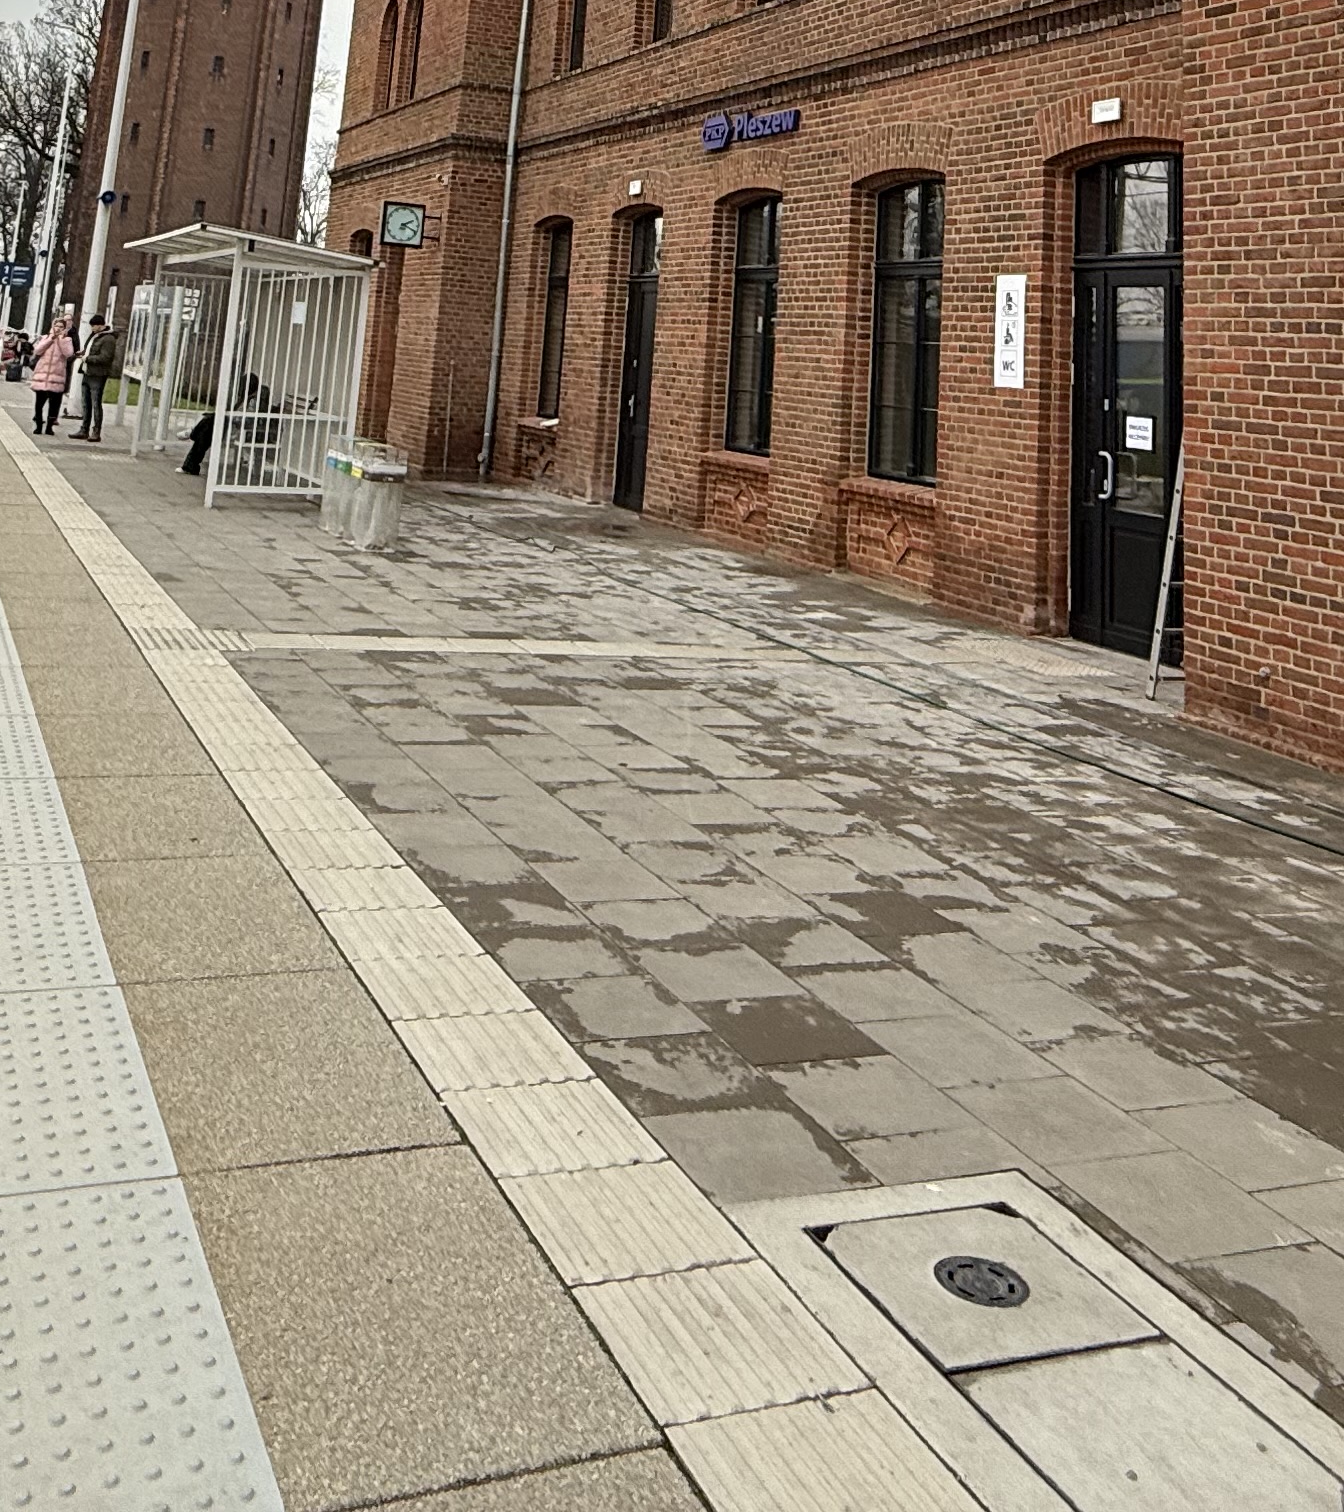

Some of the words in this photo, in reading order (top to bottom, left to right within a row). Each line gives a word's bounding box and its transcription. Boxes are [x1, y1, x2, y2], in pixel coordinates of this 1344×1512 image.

[704, 124, 725, 141] PKP
[732, 110, 795, 140] Pleszew
[1002, 359, 1015, 372] WC
